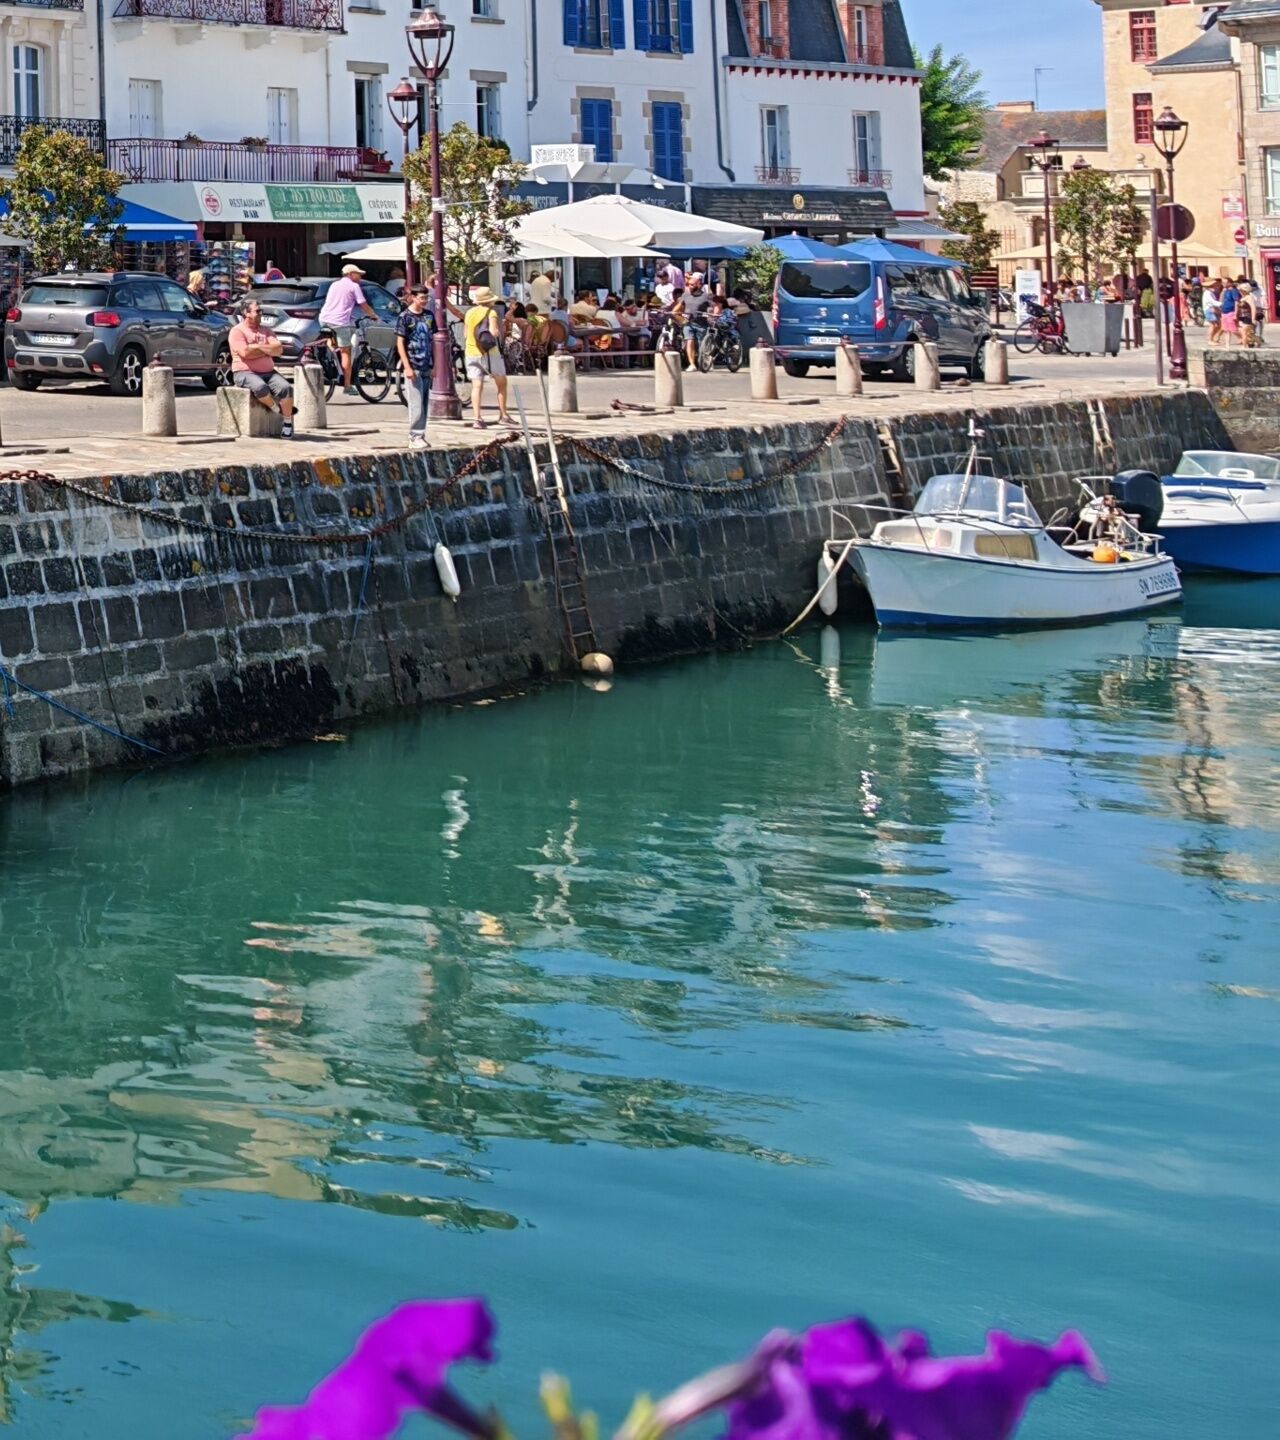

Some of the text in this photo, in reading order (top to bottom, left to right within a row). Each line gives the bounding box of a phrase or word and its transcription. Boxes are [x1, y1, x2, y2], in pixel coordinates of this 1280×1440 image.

[228, 198, 266, 208] RESTAURANT
[242, 209, 260, 219] BAR
[378, 211, 394, 220] BAR
